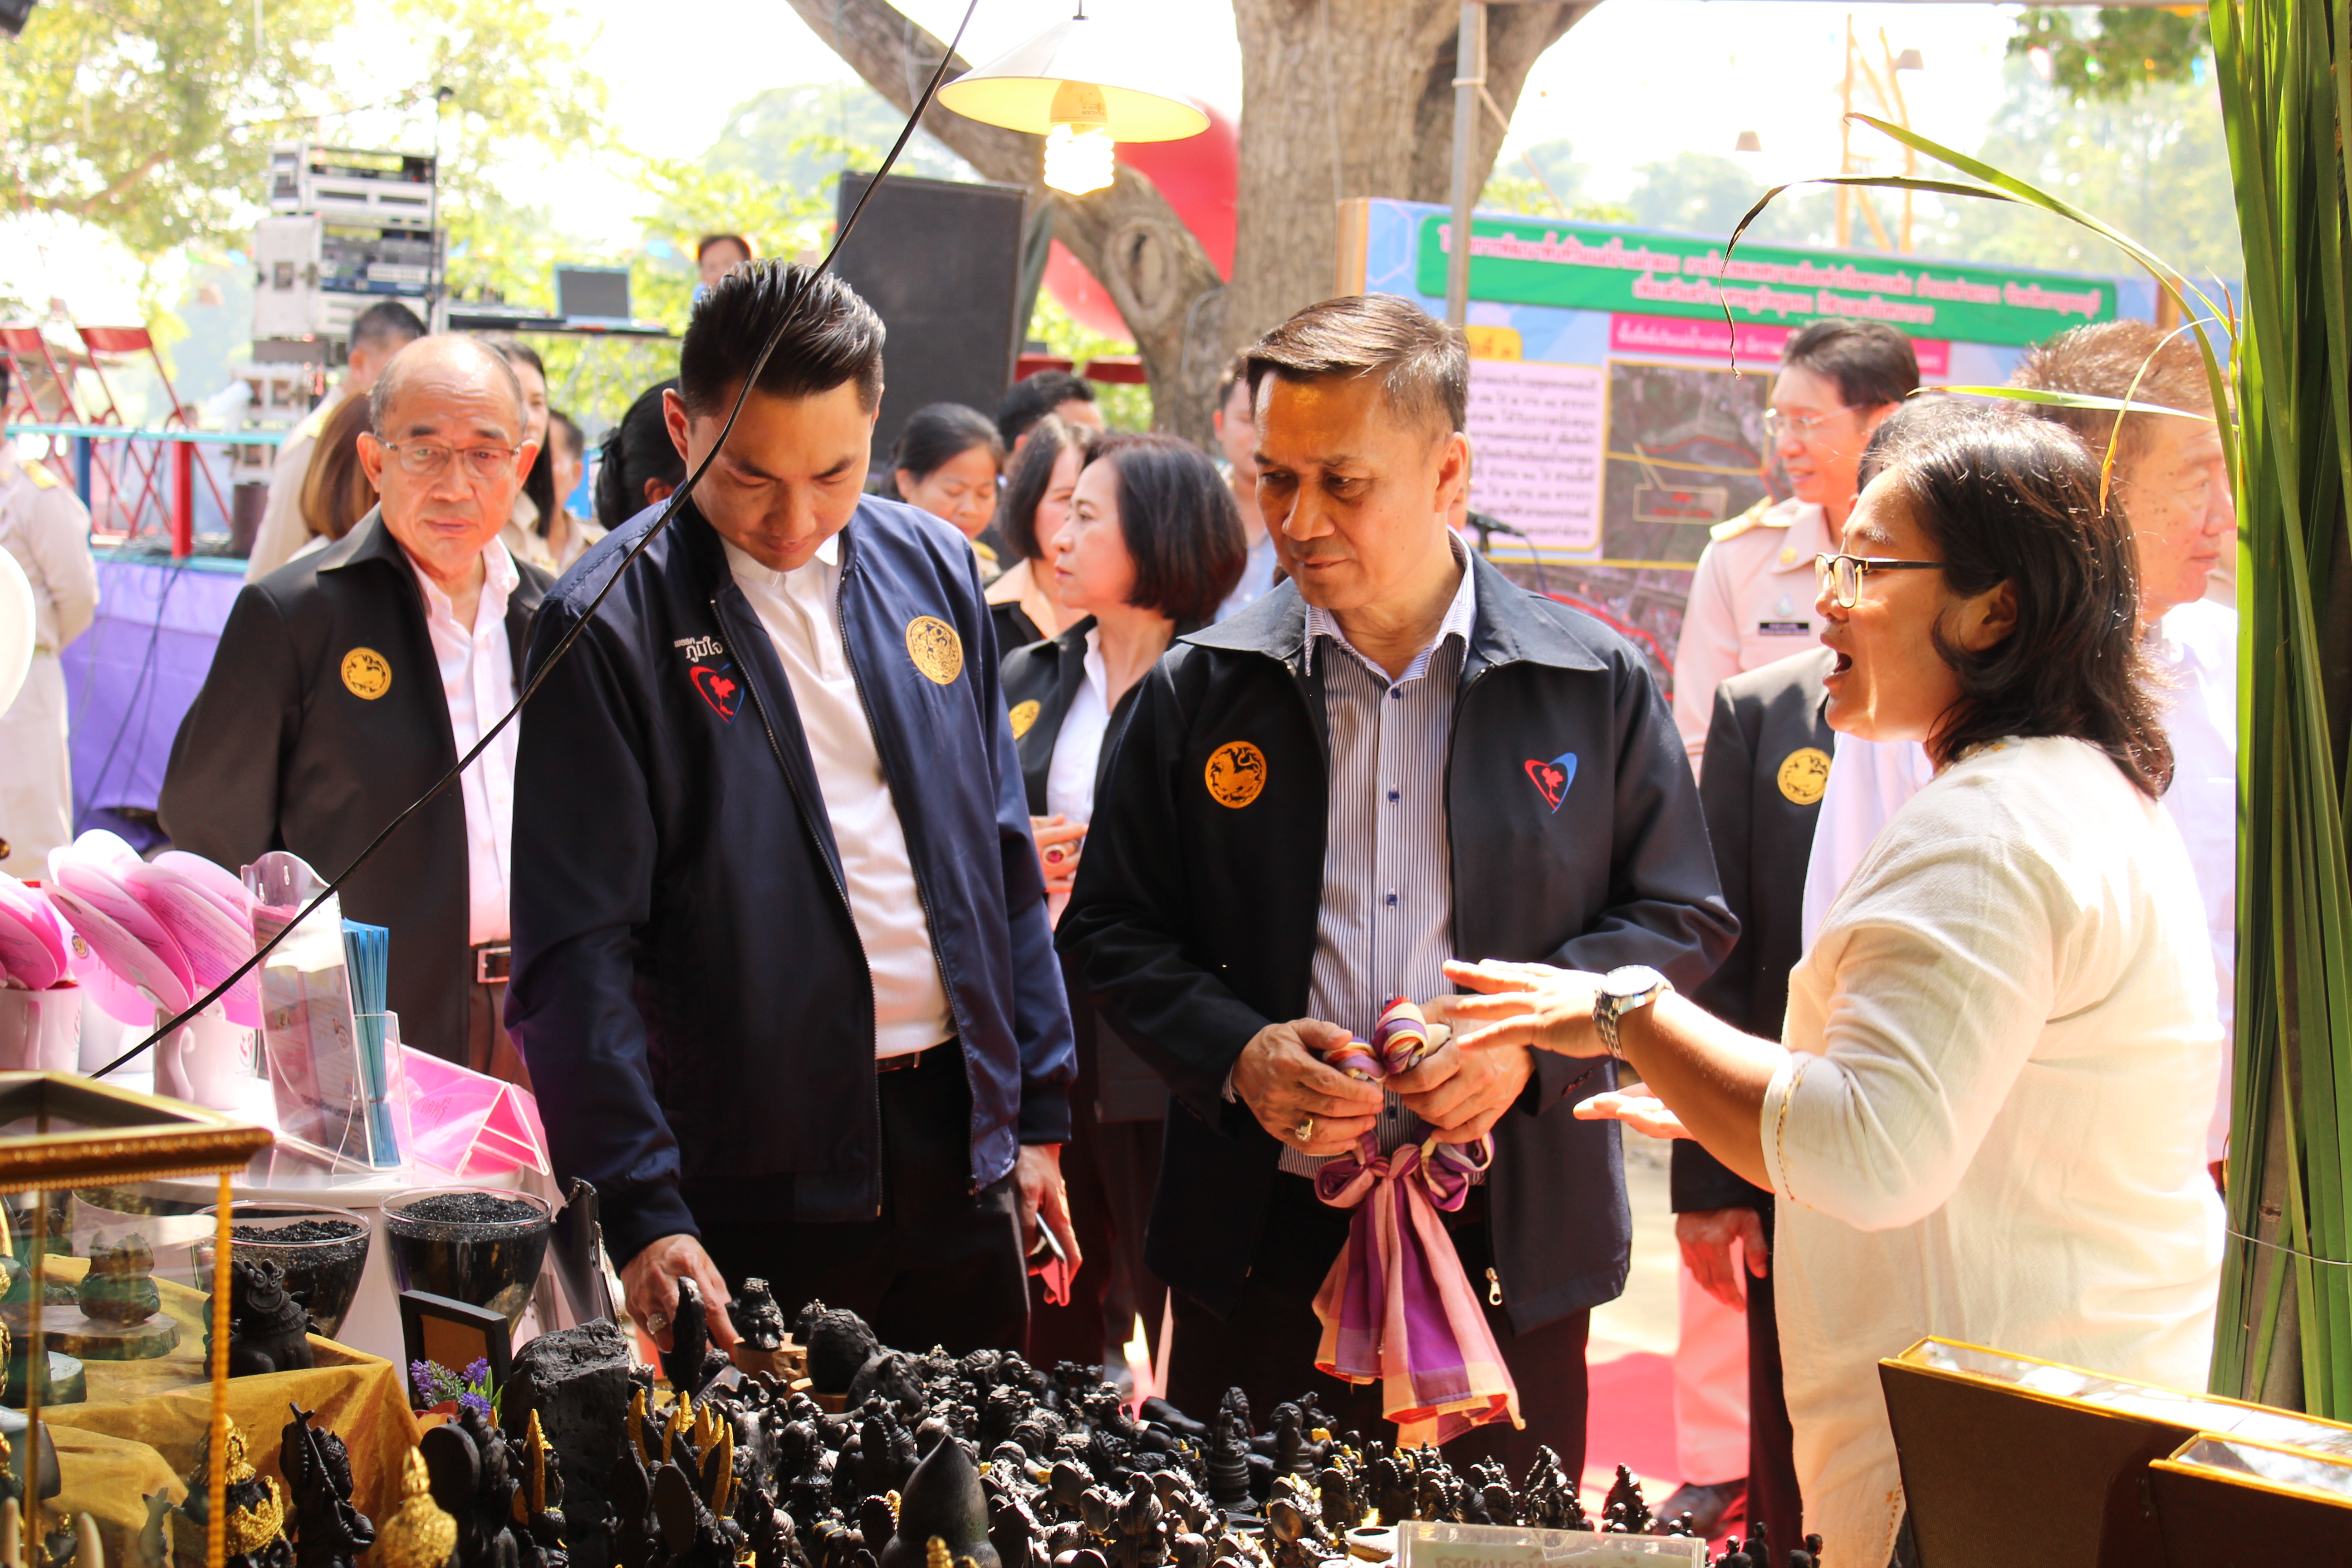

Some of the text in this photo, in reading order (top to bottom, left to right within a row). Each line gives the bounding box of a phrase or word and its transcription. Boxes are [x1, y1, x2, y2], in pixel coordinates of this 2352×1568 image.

[2005, 282, 2102, 319] จังหวัดกาญจนบุรี
[674, 637, 695, 648] พรรค
[686, 636, 724, 662] ภูมิใจ
